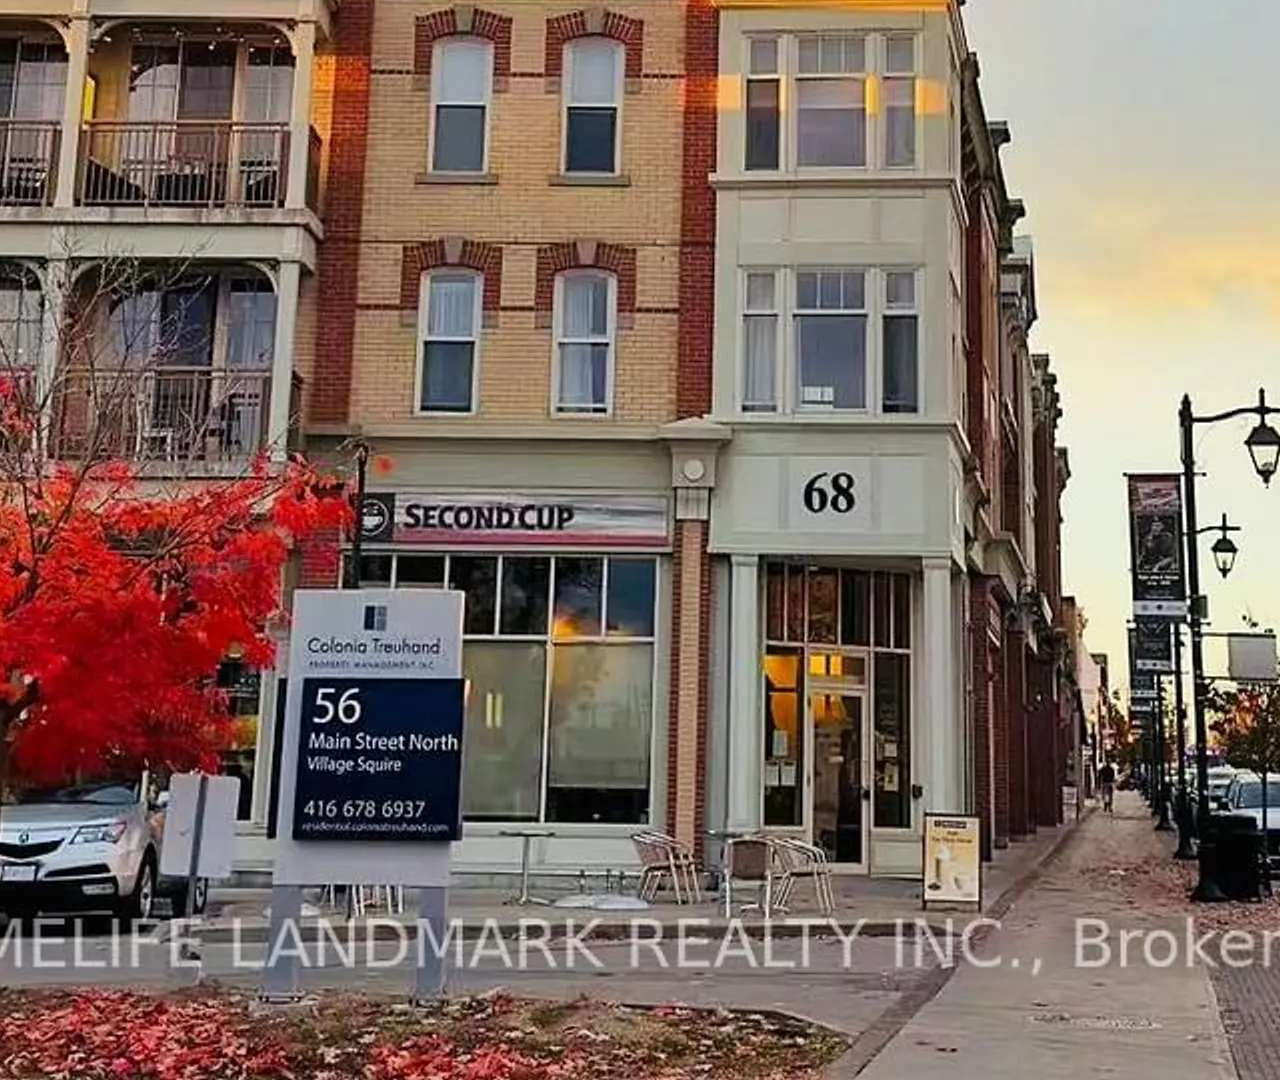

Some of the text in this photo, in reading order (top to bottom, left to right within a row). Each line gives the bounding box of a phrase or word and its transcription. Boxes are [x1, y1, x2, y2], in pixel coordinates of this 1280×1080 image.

[804, 472, 855, 513] 68
[404, 504, 575, 530] SECOND CUP
[307, 637, 441, 654] Colonia Treuhand
[312, 687, 361, 723] 56
[308, 732, 458, 751] Main Street North
[307, 756, 402, 775] Village Squire
[304, 800, 426, 818] 416 678 6937
